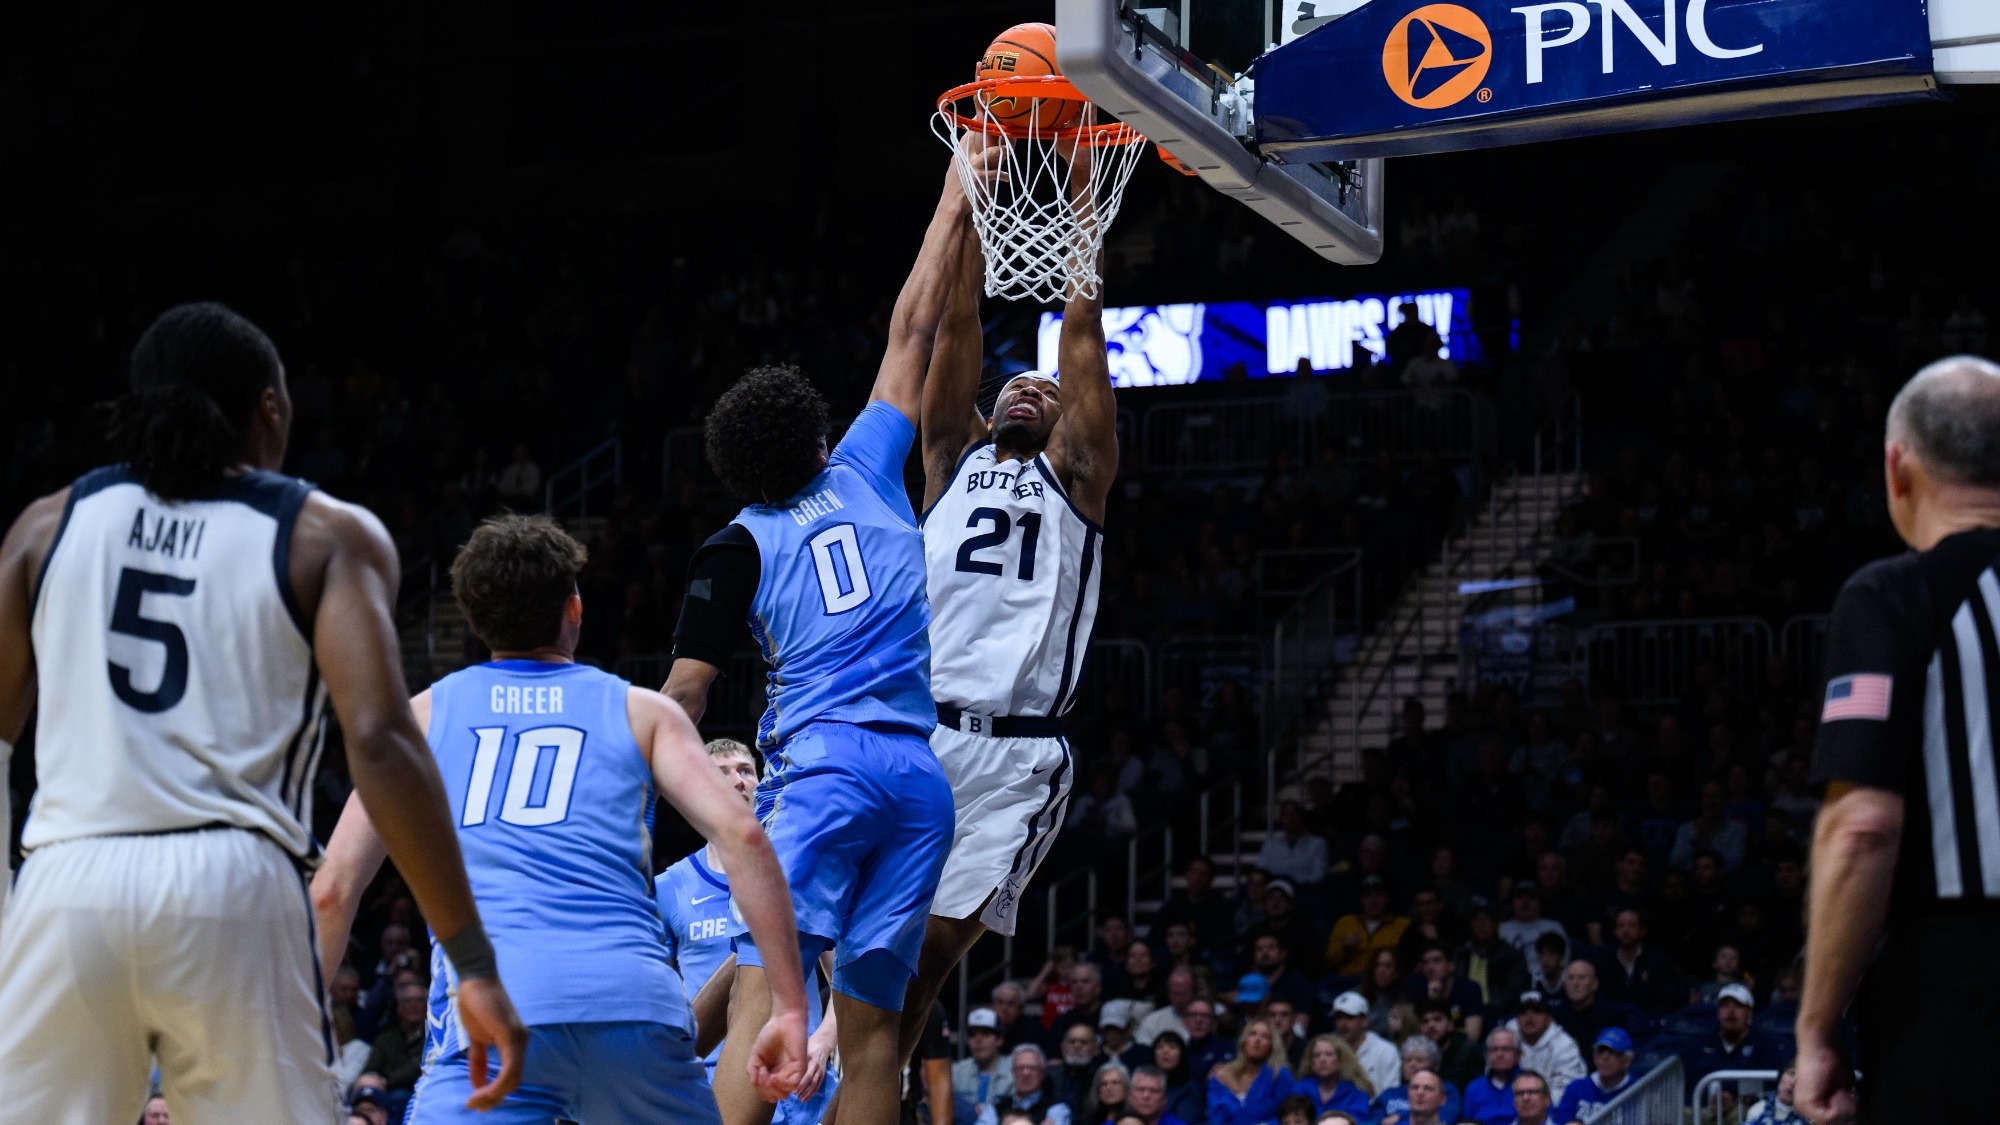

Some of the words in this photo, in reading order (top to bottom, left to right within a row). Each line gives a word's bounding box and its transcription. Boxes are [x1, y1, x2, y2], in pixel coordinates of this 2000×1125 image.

[1511, 0, 1763, 84] PNC
[789, 488, 844, 526] GREEN
[967, 471, 1045, 502] BUTER
[128, 508, 206, 560] AJAYI
[955, 507, 1042, 581] 21
[806, 522, 873, 616] 0
[107, 566, 197, 714] 5
[490, 684, 563, 715] GREER
[969, 716, 982, 733] B
[460, 724, 587, 829] 10
